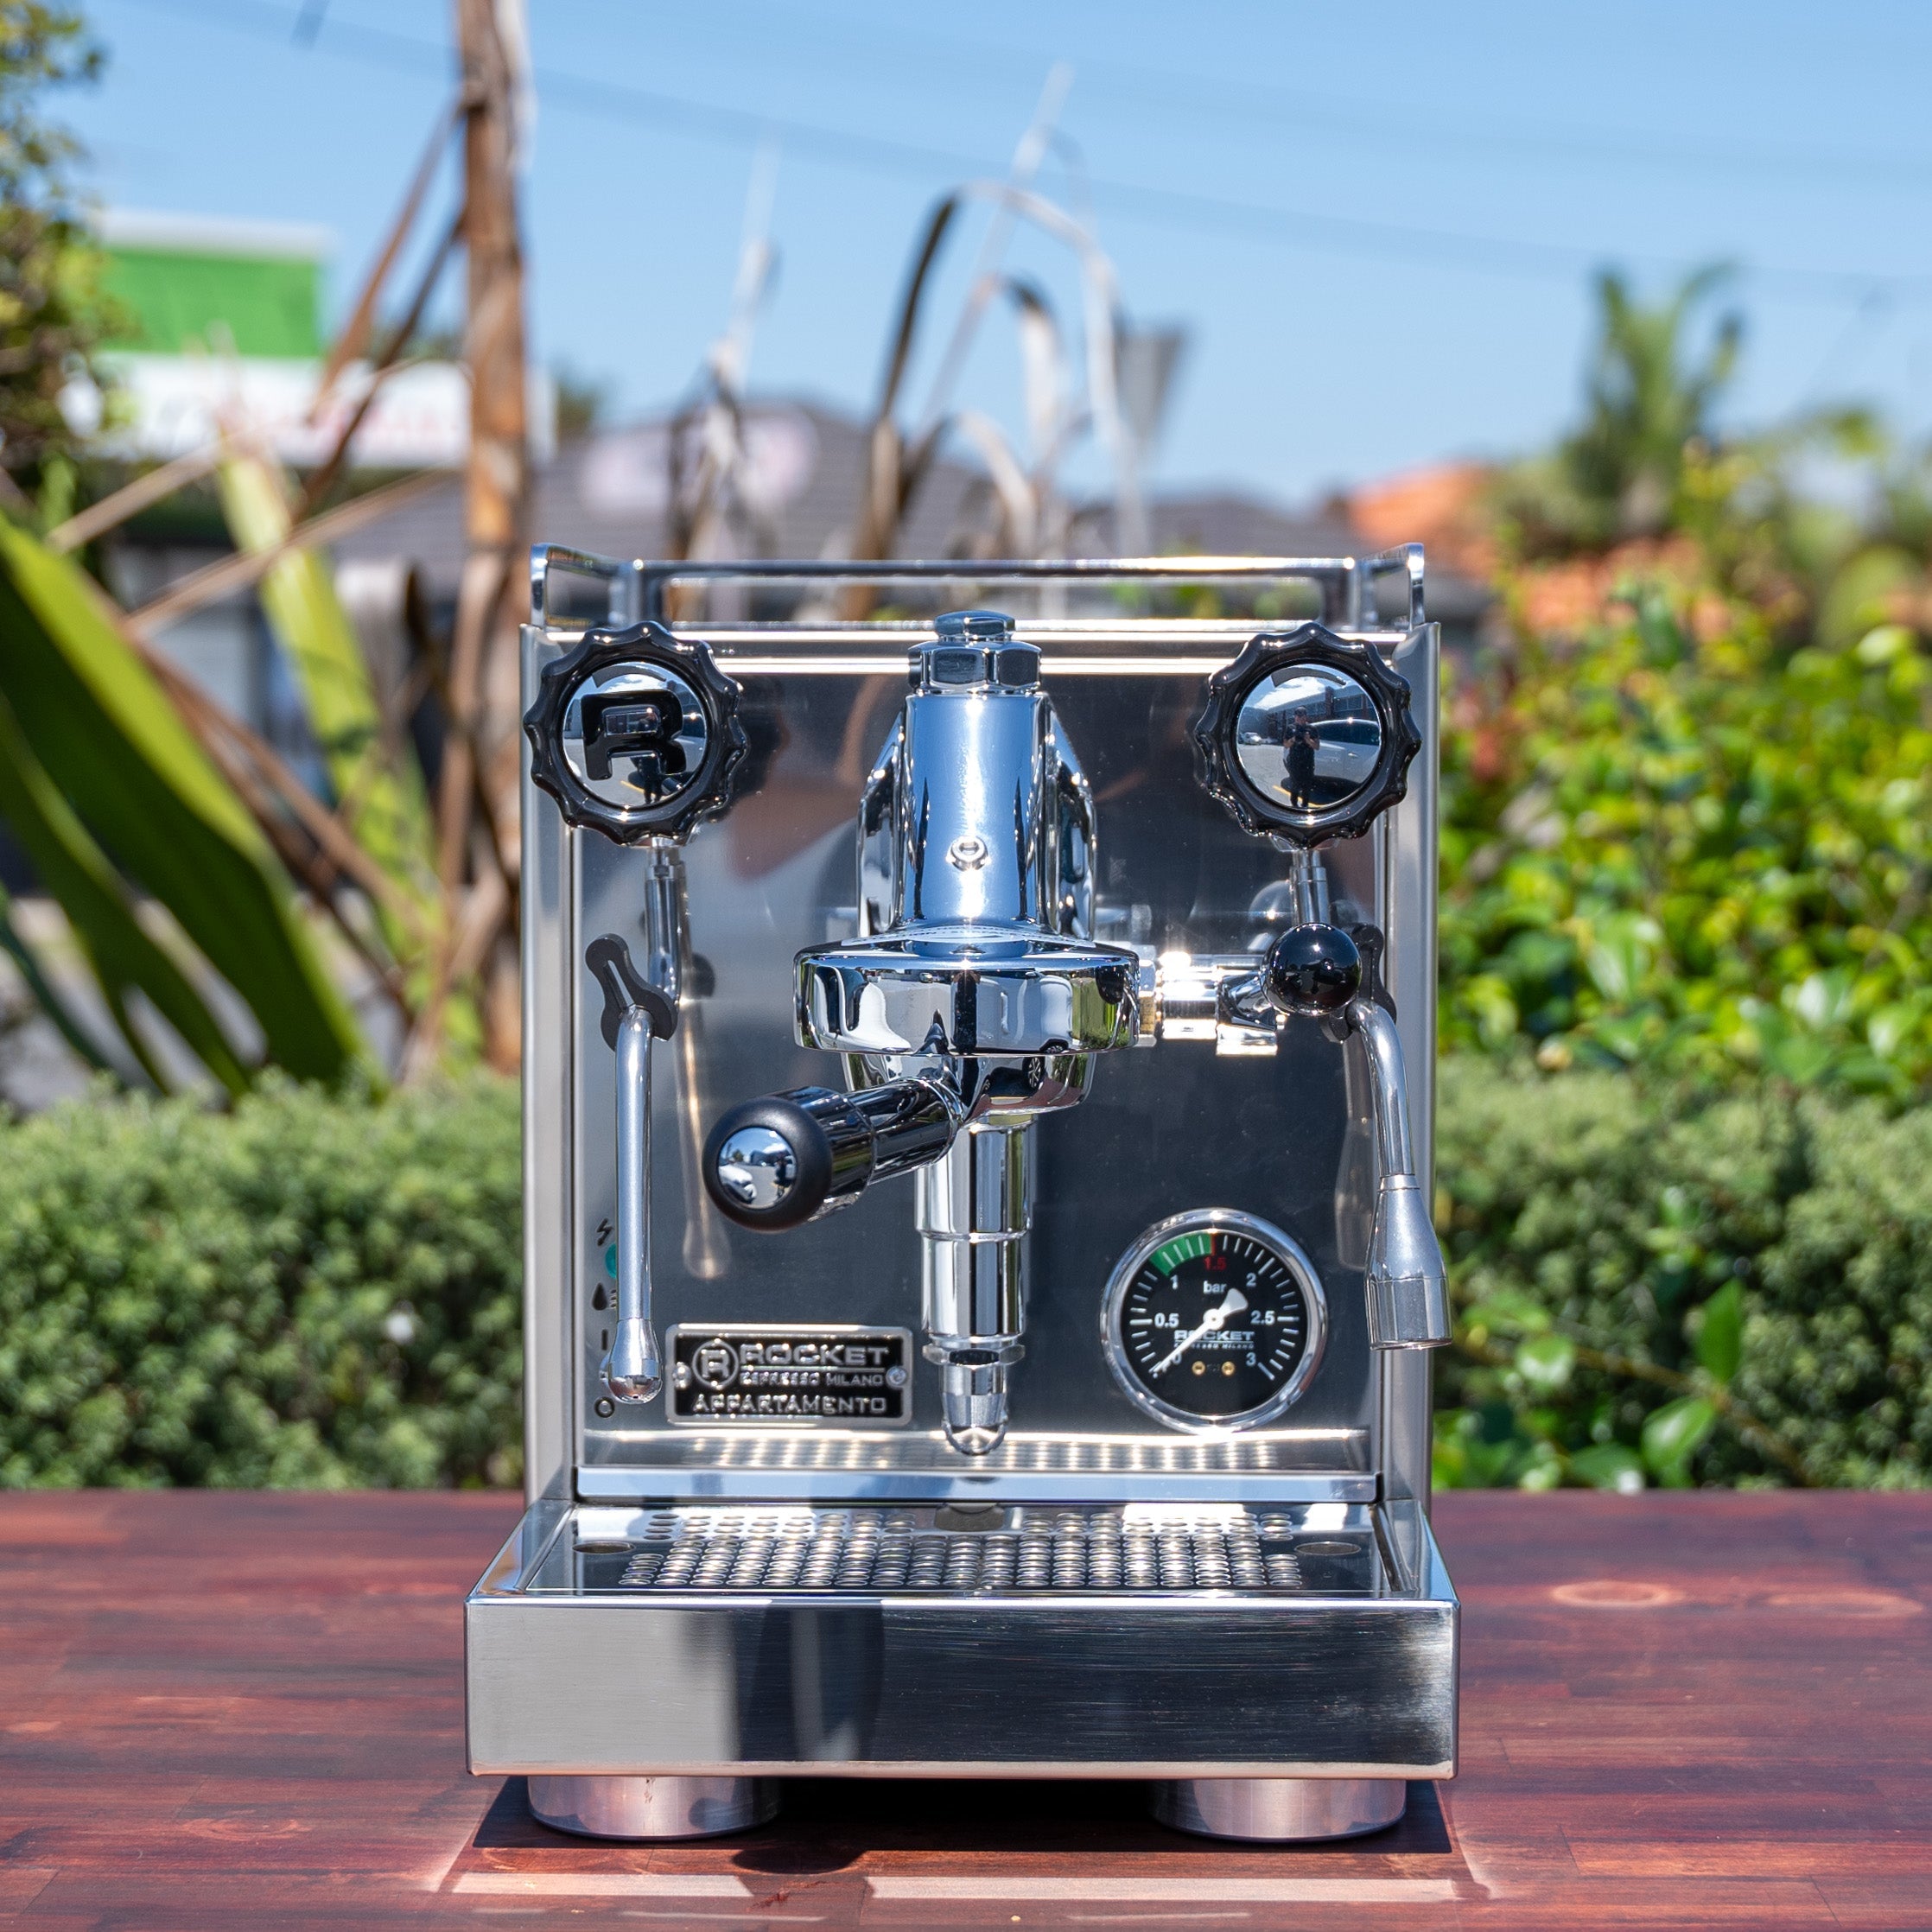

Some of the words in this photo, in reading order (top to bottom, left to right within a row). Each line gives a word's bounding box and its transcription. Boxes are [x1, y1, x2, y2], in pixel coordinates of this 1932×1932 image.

[581, 690, 686, 780] R
[1203, 1256, 1226, 1270] 1.5
[1170, 1274, 1179, 1289] 1
[1203, 1281, 1227, 1293] bar
[1246, 1273, 1256, 1287] 2
[1154, 1313, 1179, 1327] 0.5
[1251, 1311, 1274, 1325] 2.5
[740, 1344, 889, 1365] ROCKET
[1246, 1351, 1256, 1366] 3
[701, 1350, 730, 1378] R
[826, 1372, 884, 1387] MILANO
[692, 1394, 887, 1414] APPARTAMENTO
